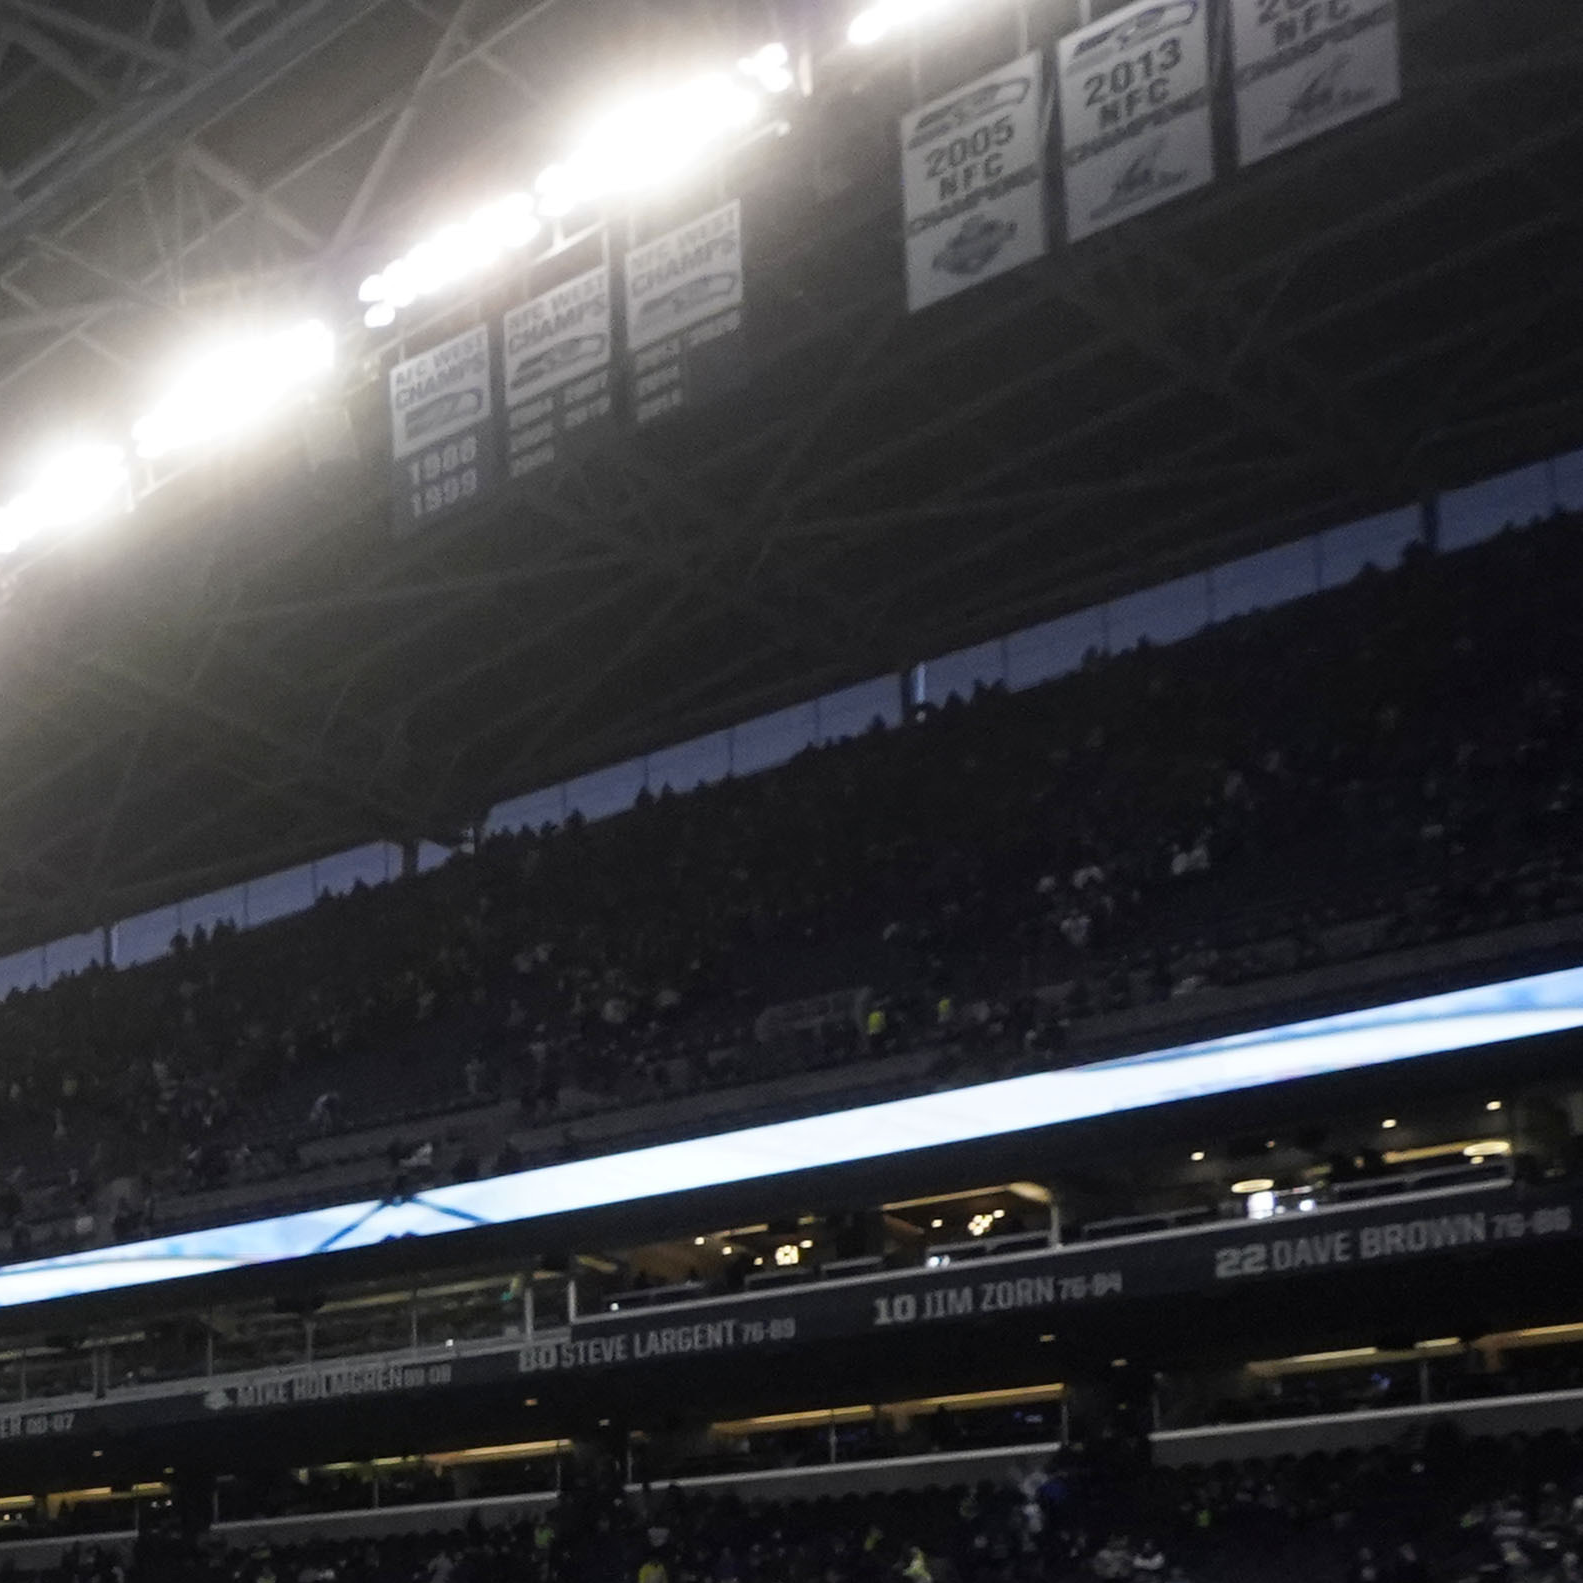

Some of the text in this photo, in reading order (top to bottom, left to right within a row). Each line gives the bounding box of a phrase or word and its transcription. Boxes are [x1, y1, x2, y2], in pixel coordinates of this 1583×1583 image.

[1084, 37, 1182, 107] 2013
[1098, 77, 1171, 129] NFC
[924, 113, 1015, 182] 2005
[940, 152, 1003, 200] NFC
[1215, 1244, 1267, 1278] 22
[1272, 1230, 1352, 1271] DAVE
[1359, 1212, 1485, 1259] BROWN
[875, 1295, 917, 1325] 10
[923, 1286, 974, 1320] JIM
[980, 1276, 1055, 1313] ZORN
[561, 1334, 628, 1369] STEVE
[634, 1318, 737, 1358] LARGENT
